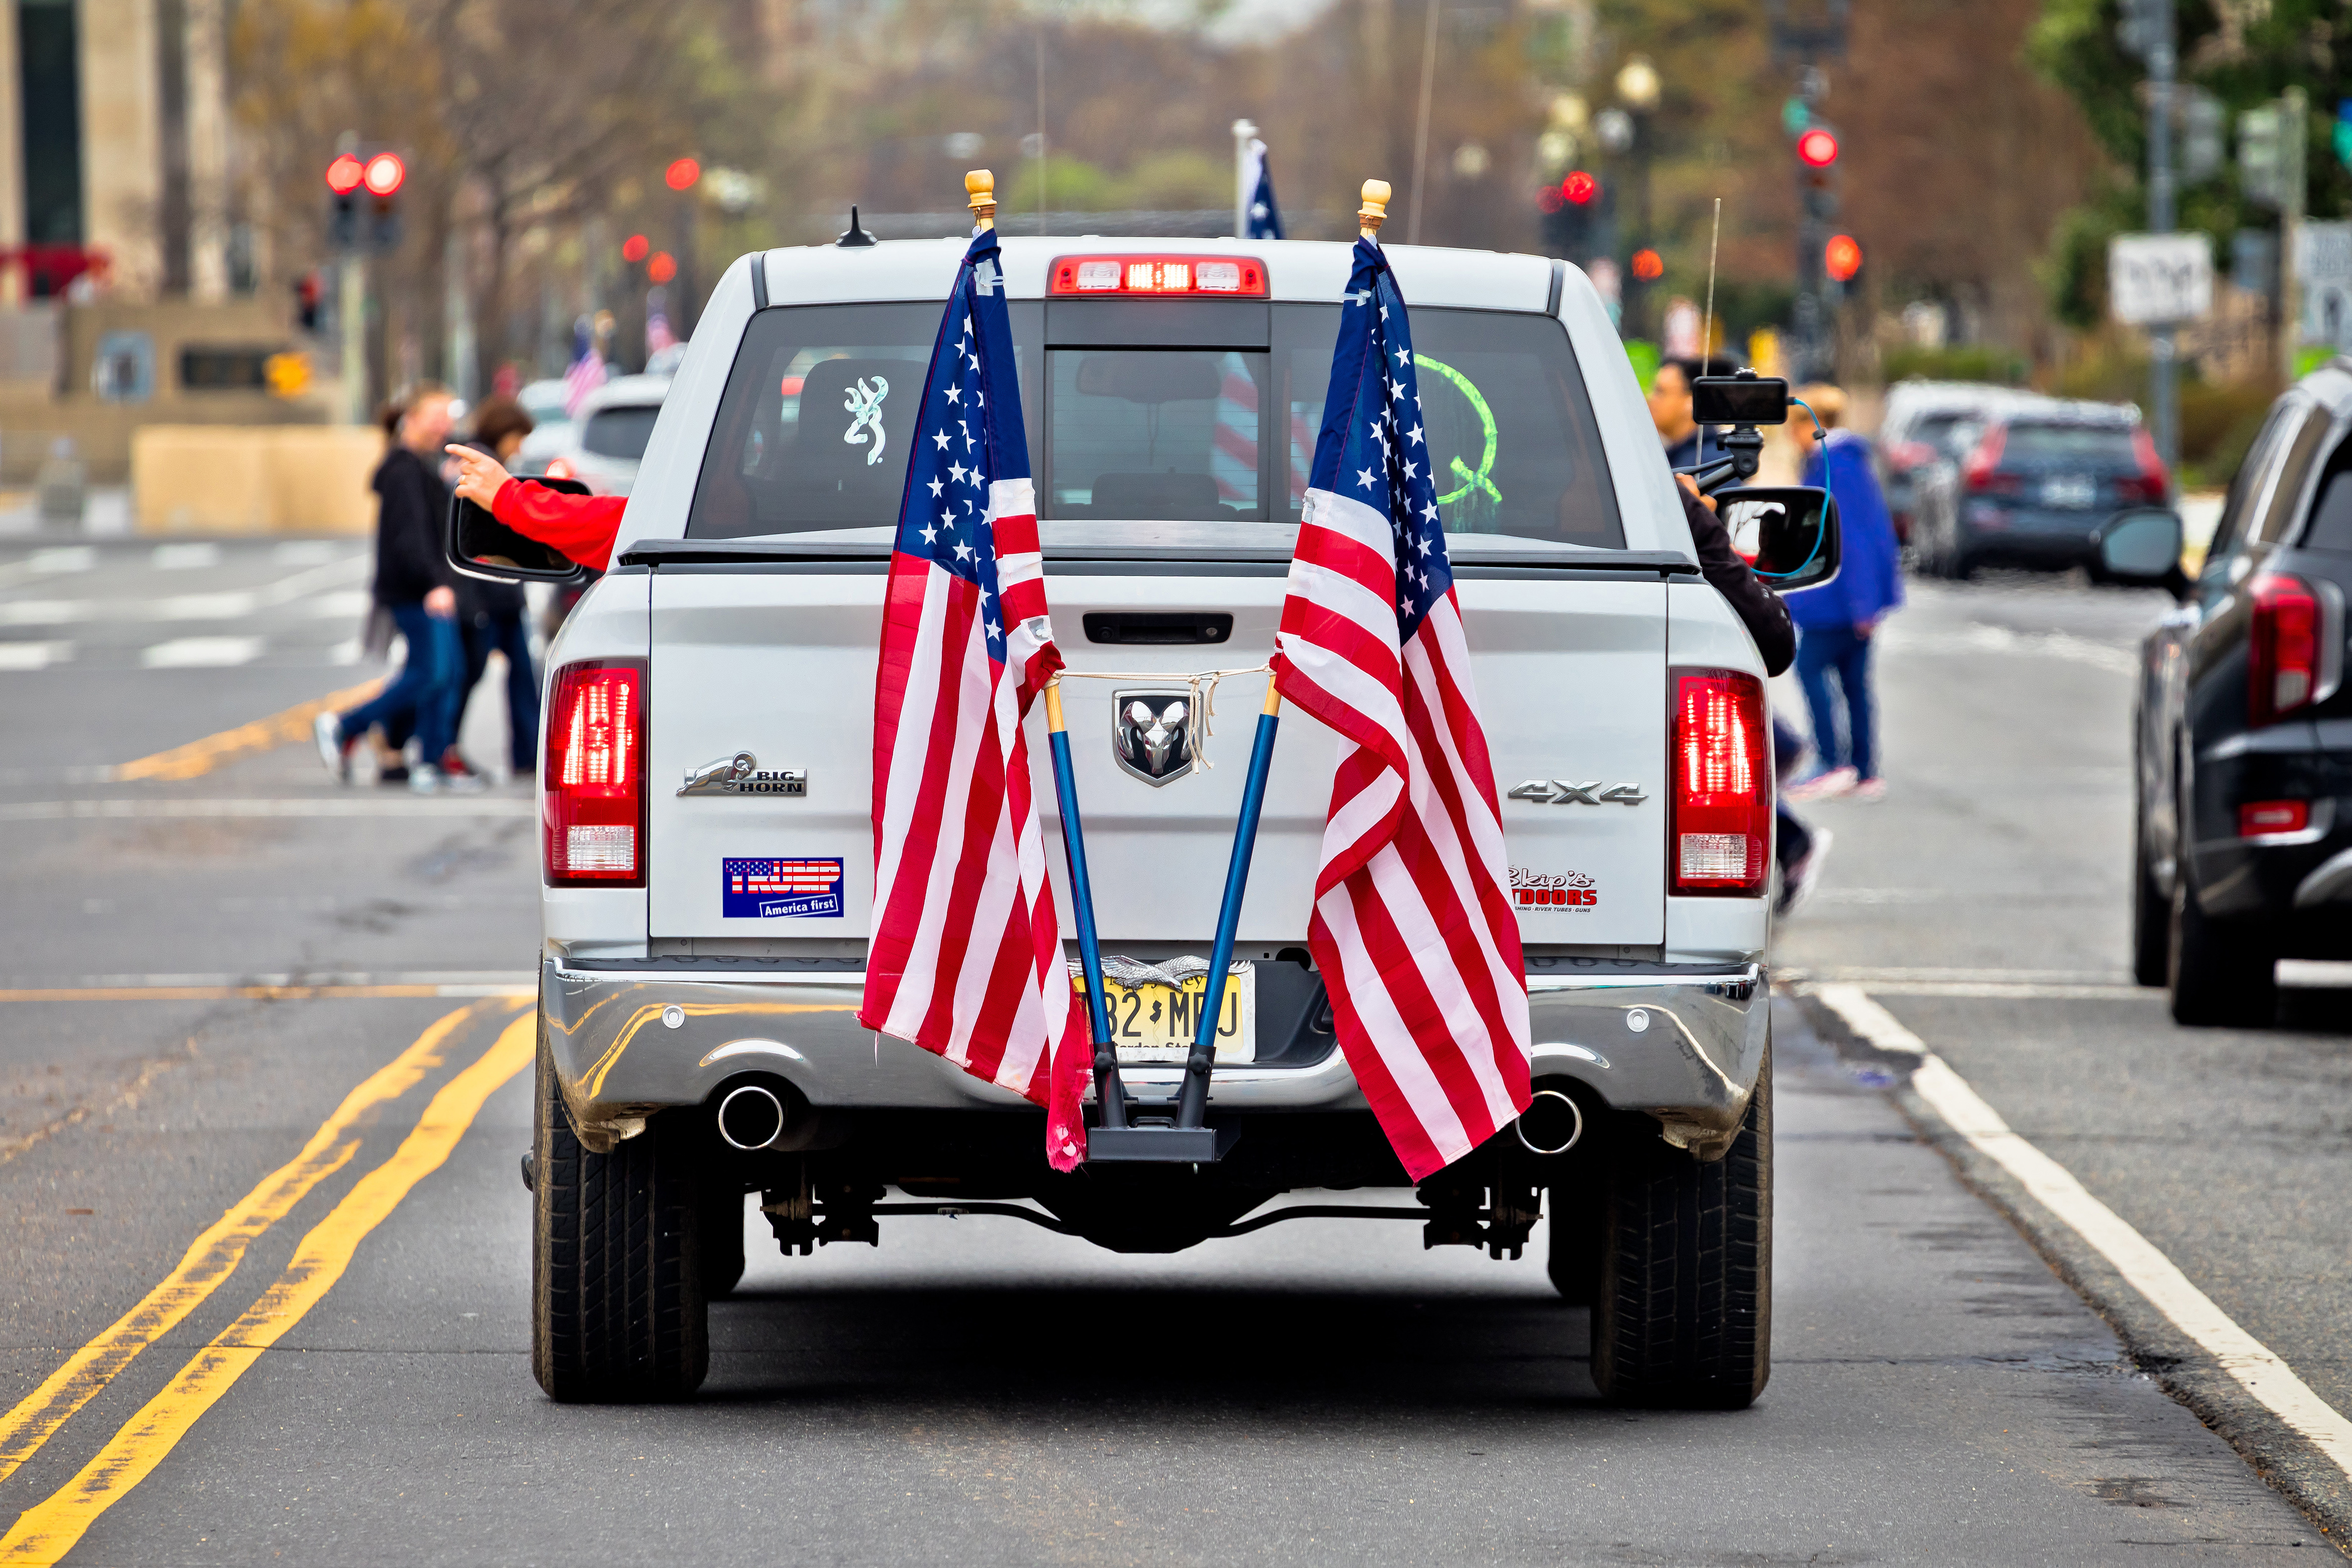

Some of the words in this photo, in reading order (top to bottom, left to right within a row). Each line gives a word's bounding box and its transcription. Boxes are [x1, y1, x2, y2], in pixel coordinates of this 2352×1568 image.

[757, 771, 794, 781] BIG
[740, 783, 802, 792] HORN
[725, 860, 841, 894] TRUMP
[765, 903, 808, 916] America
[811, 899, 834, 911] first
